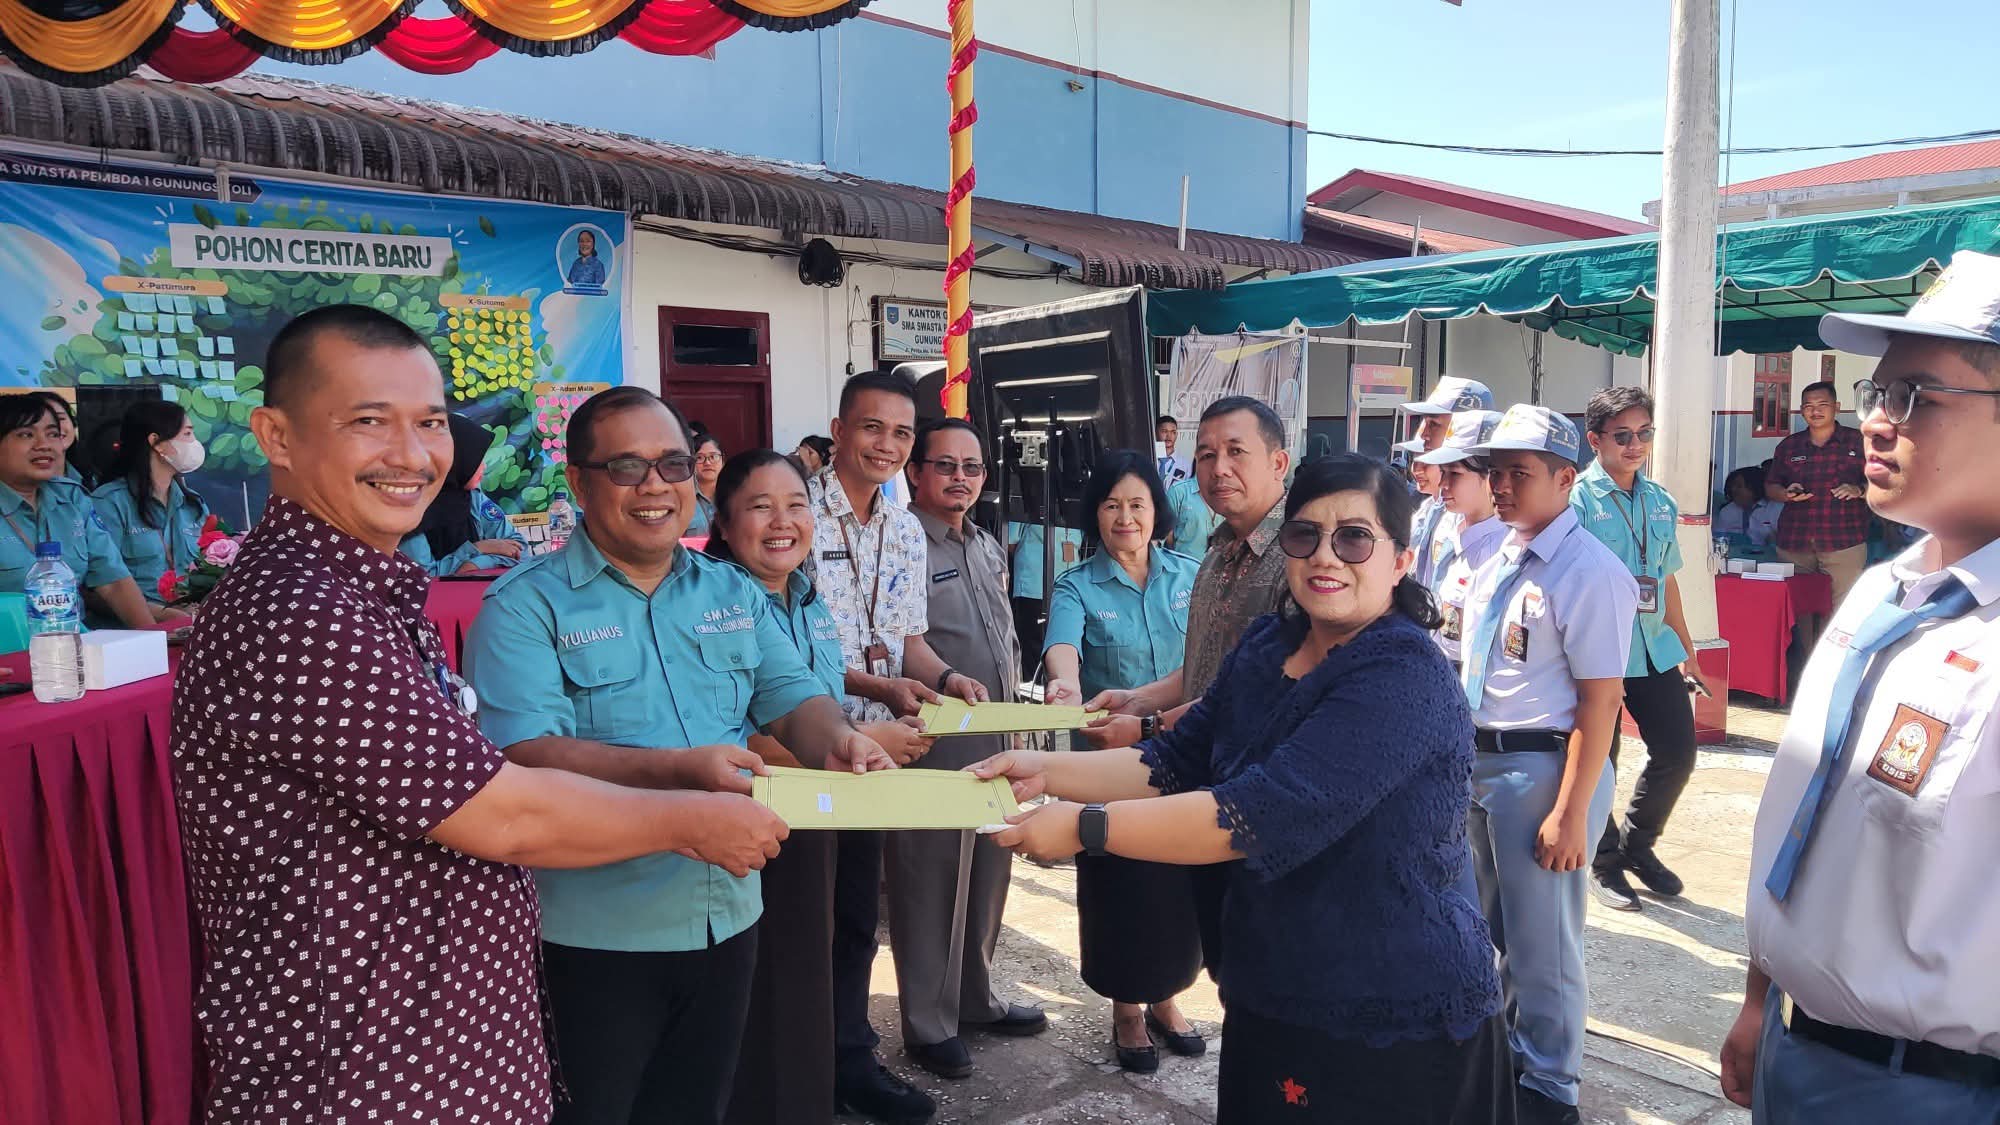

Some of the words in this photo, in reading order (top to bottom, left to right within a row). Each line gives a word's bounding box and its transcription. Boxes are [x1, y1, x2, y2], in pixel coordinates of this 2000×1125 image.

[11, 162, 78, 180] SWASTA
[81, 169, 142, 186] PEMBDA
[195, 234, 284, 264] POHON
[288, 239, 370, 267] CERITA
[372, 242, 432, 269] BARU
[908, 308, 941, 319] KANTOR
[901, 320, 916, 331] SMA
[916, 321, 943, 333] SWASTA
[914, 335, 943, 345] GUNUNG
[37, 593, 71, 607] AQUA
[703, 607, 731, 622] SMA
[559, 624, 624, 649] YULIANUS
[1882, 763, 1906, 779] OSIS
